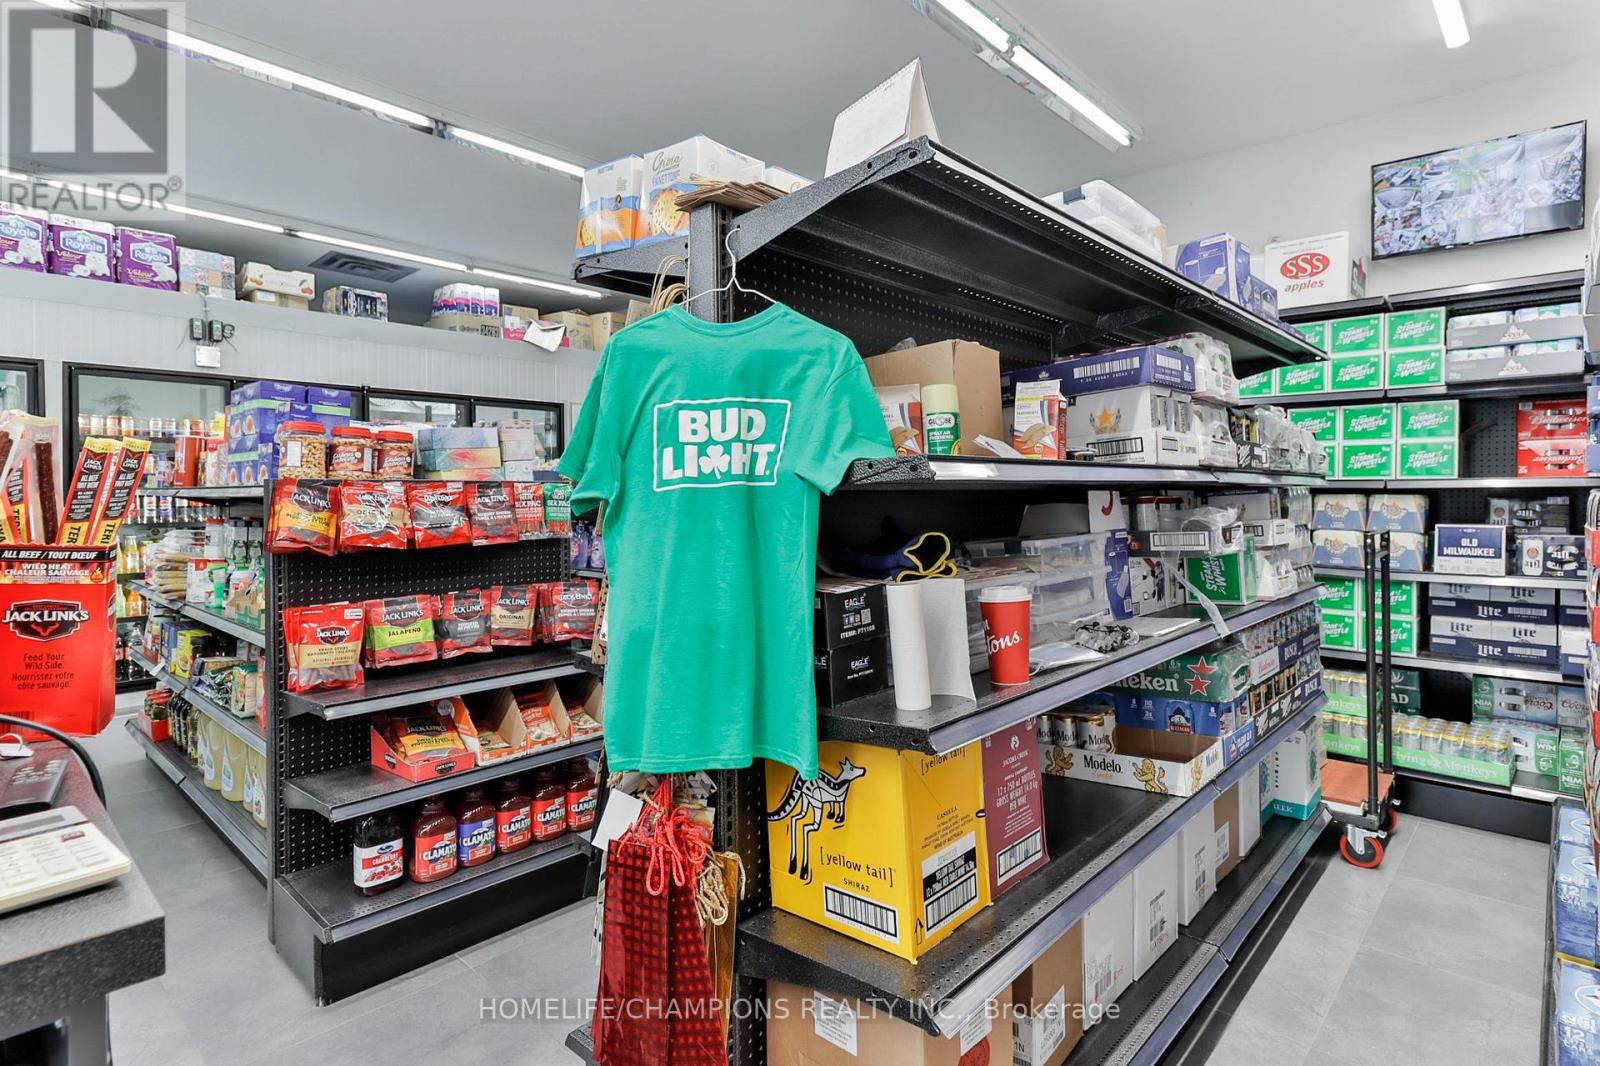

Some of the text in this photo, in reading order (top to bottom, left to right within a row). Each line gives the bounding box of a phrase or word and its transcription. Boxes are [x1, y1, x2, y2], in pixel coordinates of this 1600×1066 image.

[66, 237, 104, 251] Royale
[134, 250, 168, 262] Royale
[1284, 279, 1324, 293] apples
[678, 408, 766, 442] BUD
[1461, 538, 1478, 546] OLD
[20, 550, 42, 558] BEEF
[1444, 547, 1495, 557] MILWAUKEE
[844, 596, 865, 608] EAGLE
[450, 606, 466, 614] JACK
[1477, 606, 1502, 617] Lite
[2, 610, 42, 623] JACK
[382, 612, 400, 622] JACK
[1450, 622, 1472, 632] Lite
[1512, 627, 1536, 638] Lite
[1477, 644, 1502, 656] Lite
[24, 662, 44, 670] Wild
[851, 656, 868, 668] EAGLE
[1536, 742, 1556, 752] WIN
[1084, 754, 1123, 774] Modelo
[372, 852, 399, 866] CRANBERRY
[844, 878, 870, 892] SHIRAZ
[1566, 1026, 1584, 1042] 12
